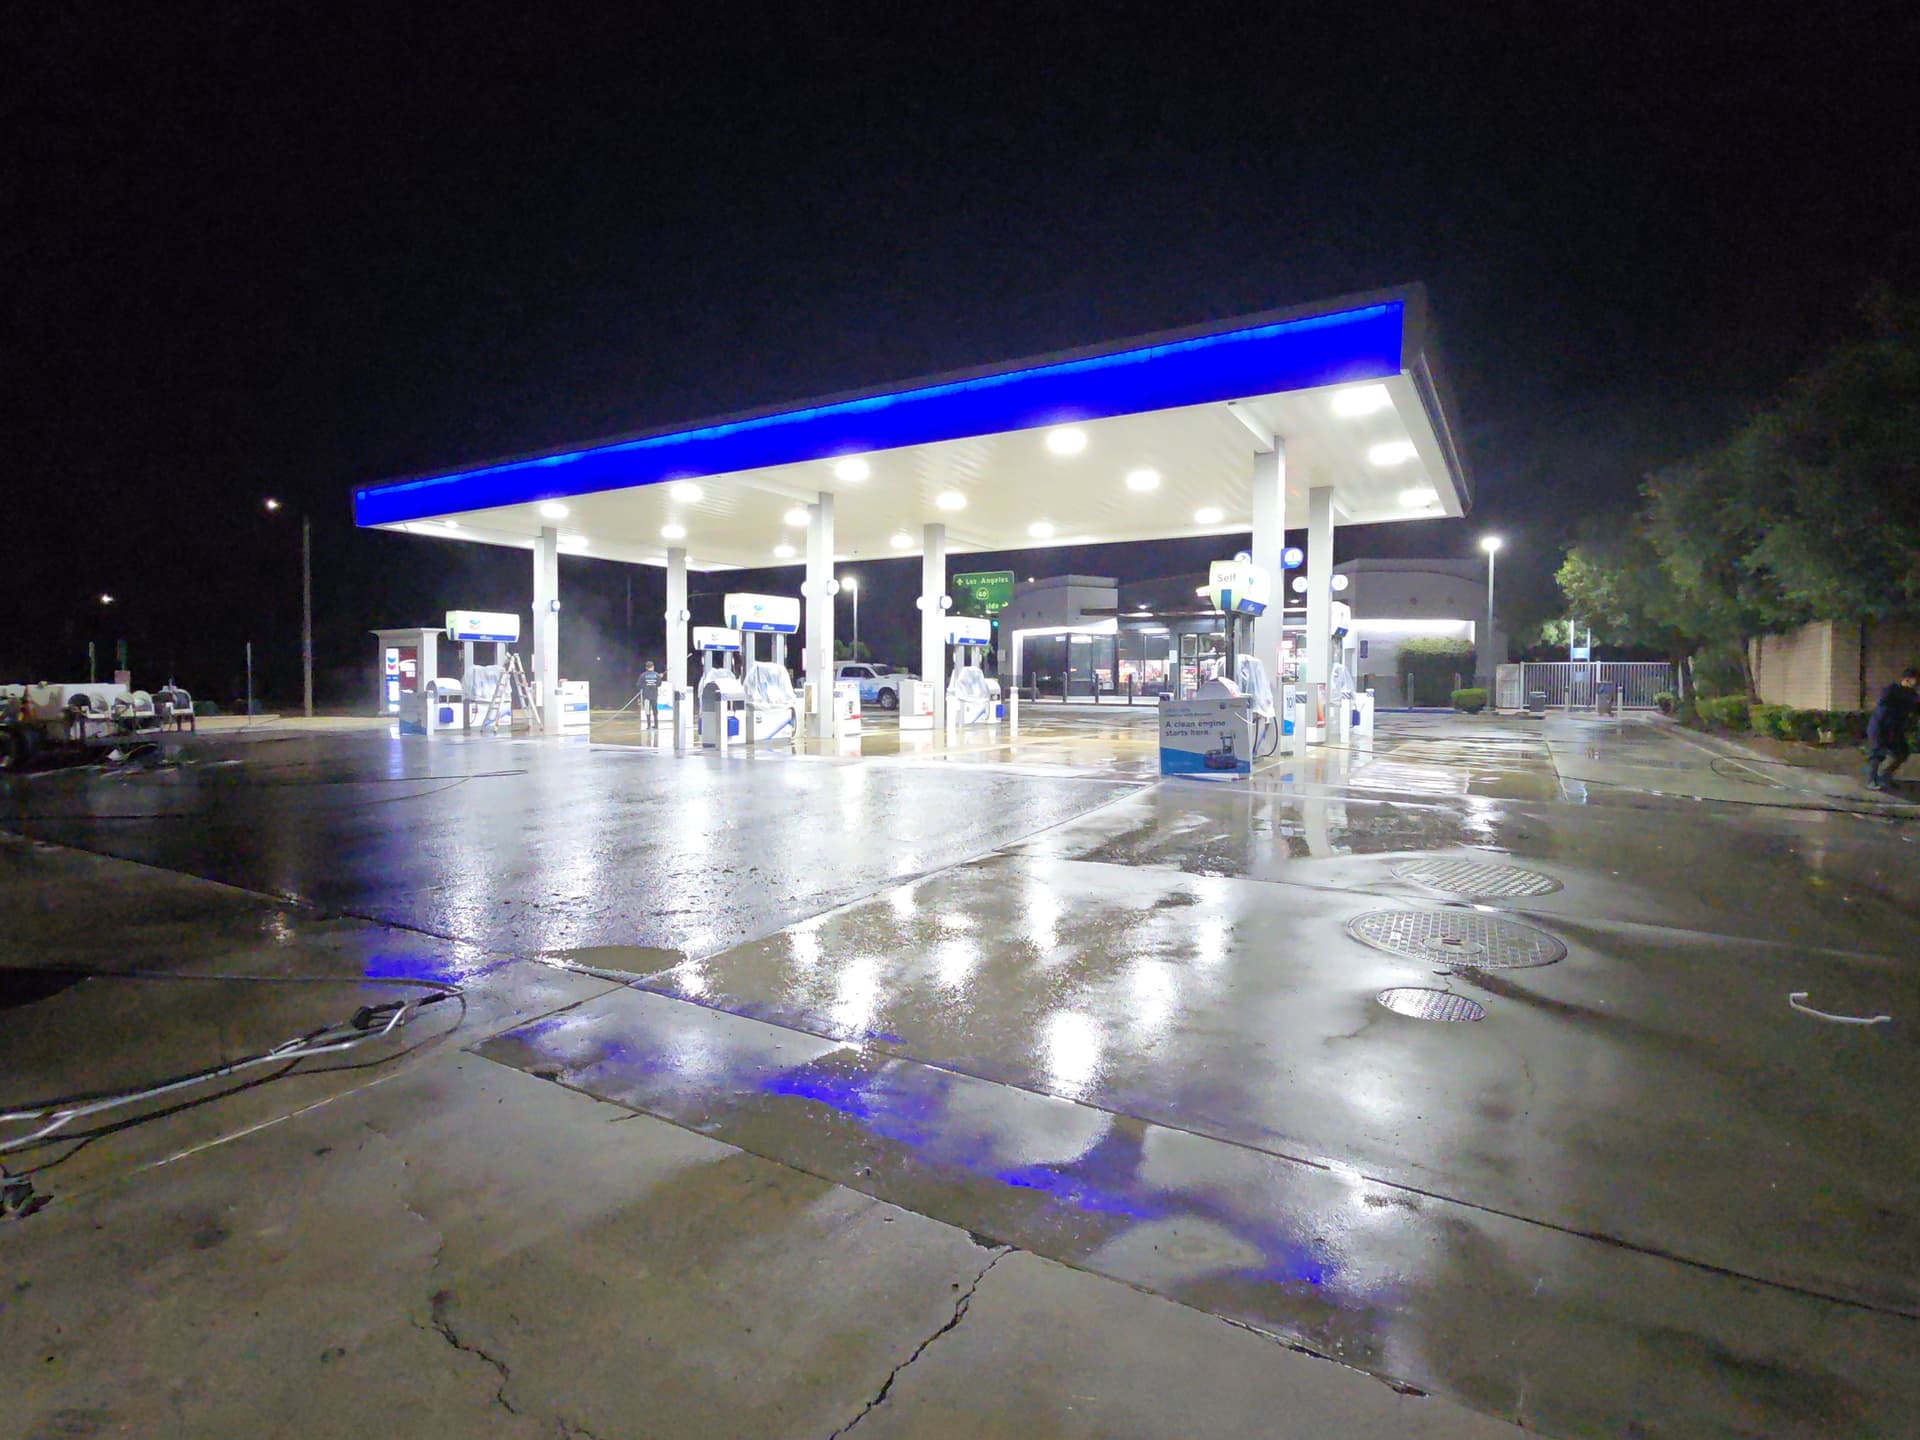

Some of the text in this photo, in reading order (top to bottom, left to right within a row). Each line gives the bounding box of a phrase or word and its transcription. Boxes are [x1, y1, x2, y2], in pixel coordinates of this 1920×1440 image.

[981, 577, 1009, 585] Angeles
[1216, 573, 1236, 583] Self
[1198, 720, 1226, 728] engine
